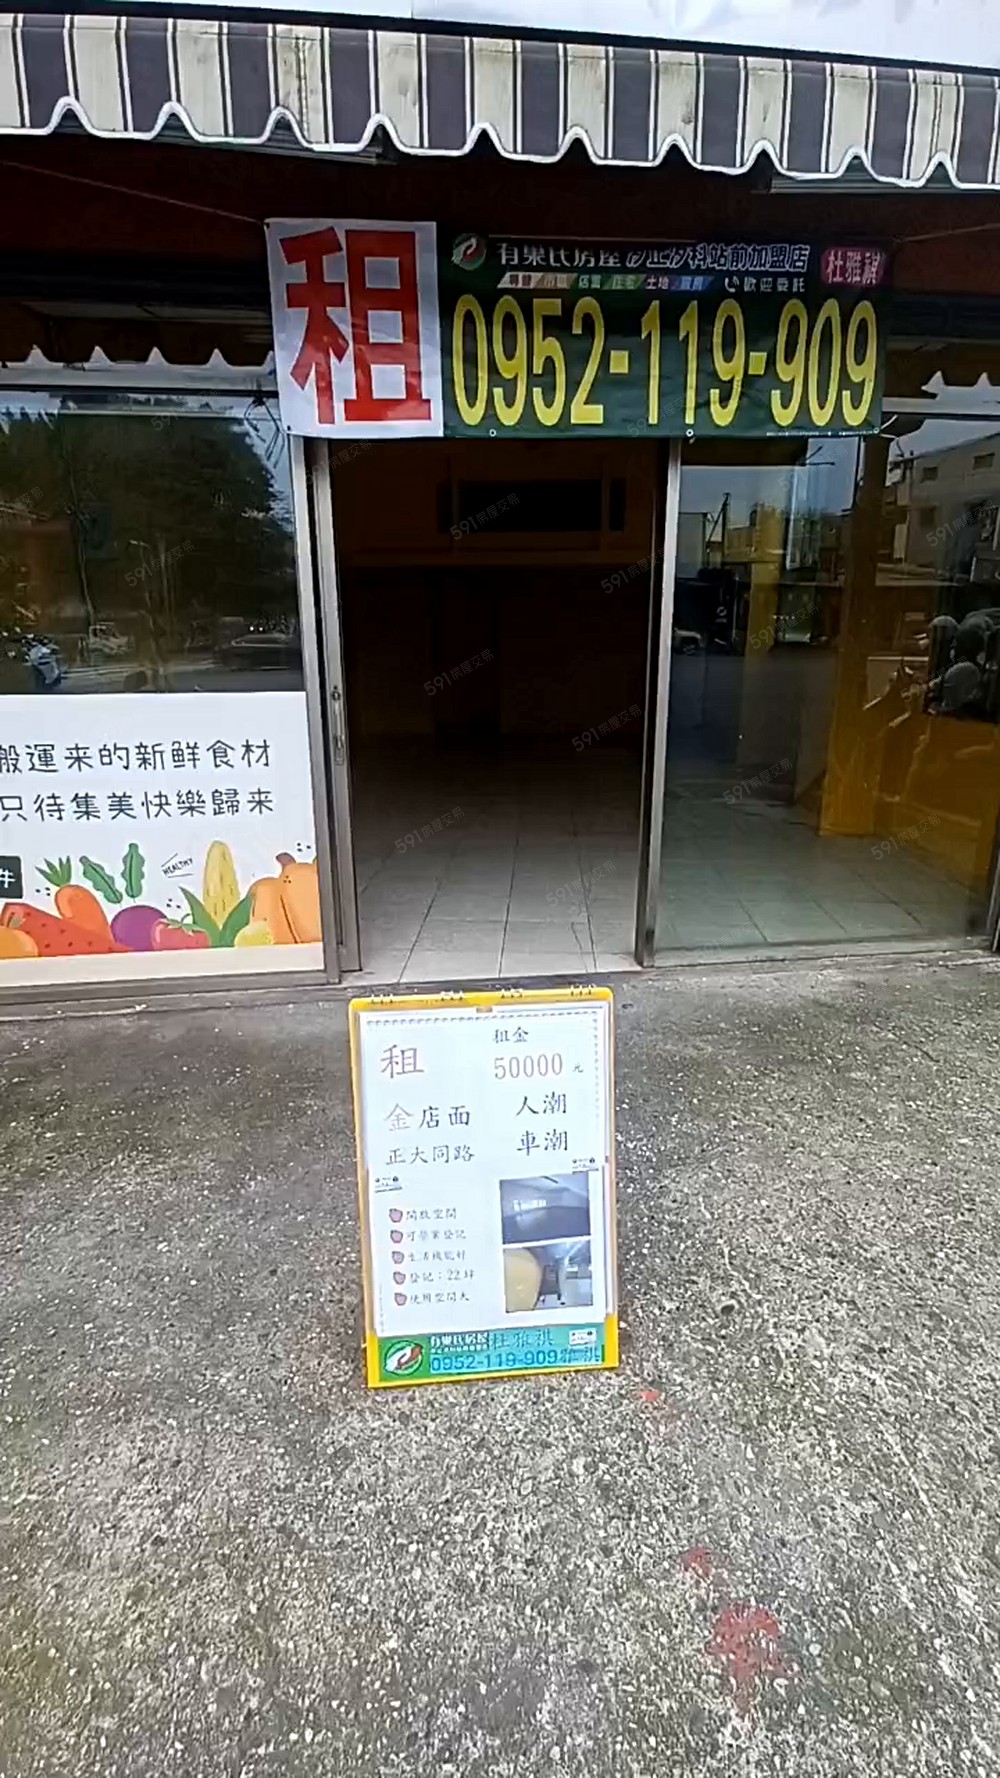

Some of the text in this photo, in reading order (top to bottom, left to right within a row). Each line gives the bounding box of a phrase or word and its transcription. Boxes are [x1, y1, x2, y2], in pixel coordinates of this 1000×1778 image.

[279, 225, 431, 425] 租
[452, 294, 878, 427] 0952-119-909
[162, 858, 193, 876] HEALTHY
[492, 1026, 529, 1044] 租金
[380, 1044, 424, 1079] 租
[494, 1053, 563, 1079] 50000
[516, 1091, 567, 1116] 人潮
[384, 1103, 471, 1131] 金店面
[385, 1144, 475, 1166] 正大同路
[516, 1128, 568, 1156] 車潮
[431, 1349, 557, 1372] 0952-119-909
